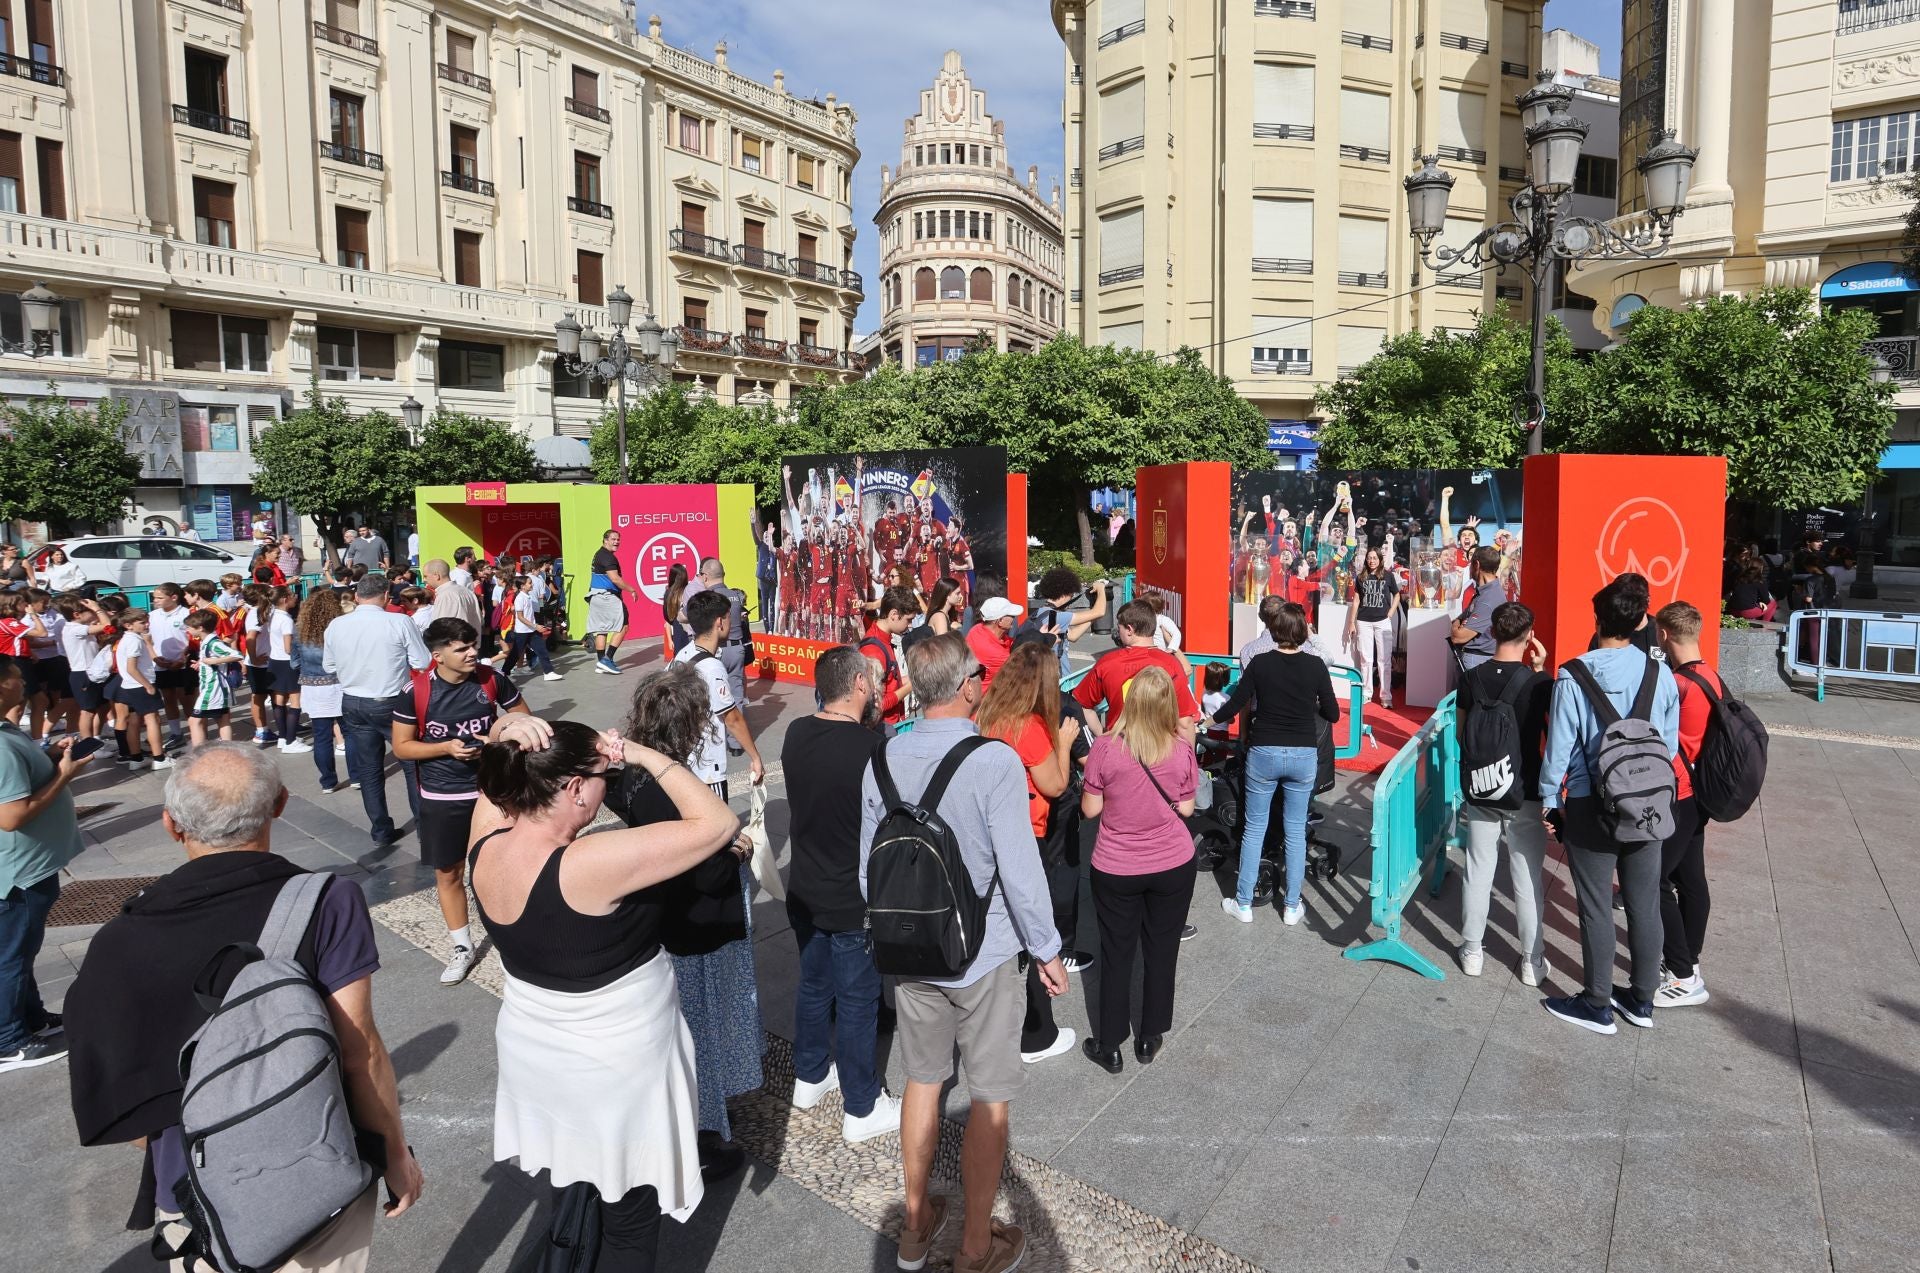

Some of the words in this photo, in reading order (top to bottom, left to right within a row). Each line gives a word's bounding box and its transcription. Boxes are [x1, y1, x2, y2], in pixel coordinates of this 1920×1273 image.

[634, 512, 712, 525] ESEFUTBOL
[752, 656, 806, 676] FÚTBOL
[1471, 754, 1514, 795] NIKE
